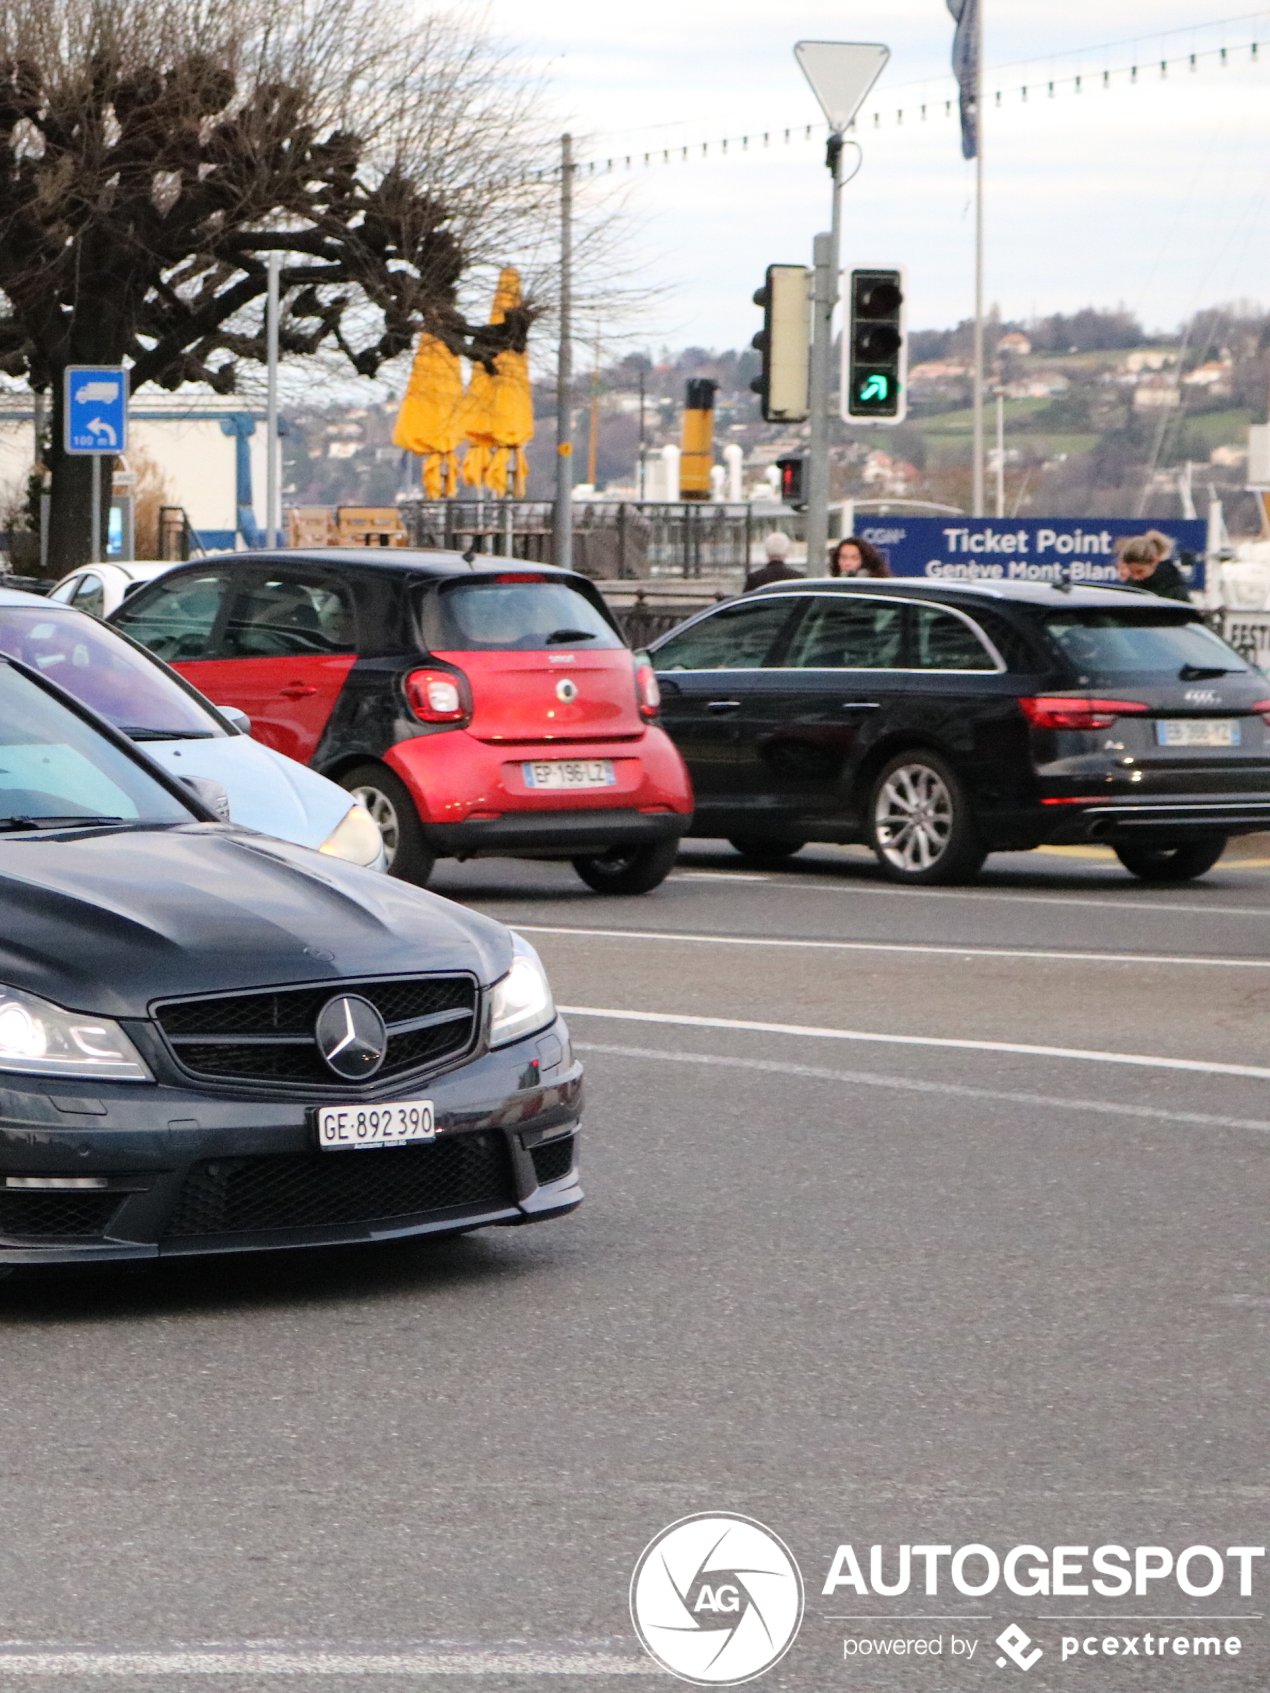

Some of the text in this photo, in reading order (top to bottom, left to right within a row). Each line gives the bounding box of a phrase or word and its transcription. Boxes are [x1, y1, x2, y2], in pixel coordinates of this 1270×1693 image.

[943, 528, 1112, 554] Ticket Point
[925, 559, 1121, 581] Genève Mont-Blan
